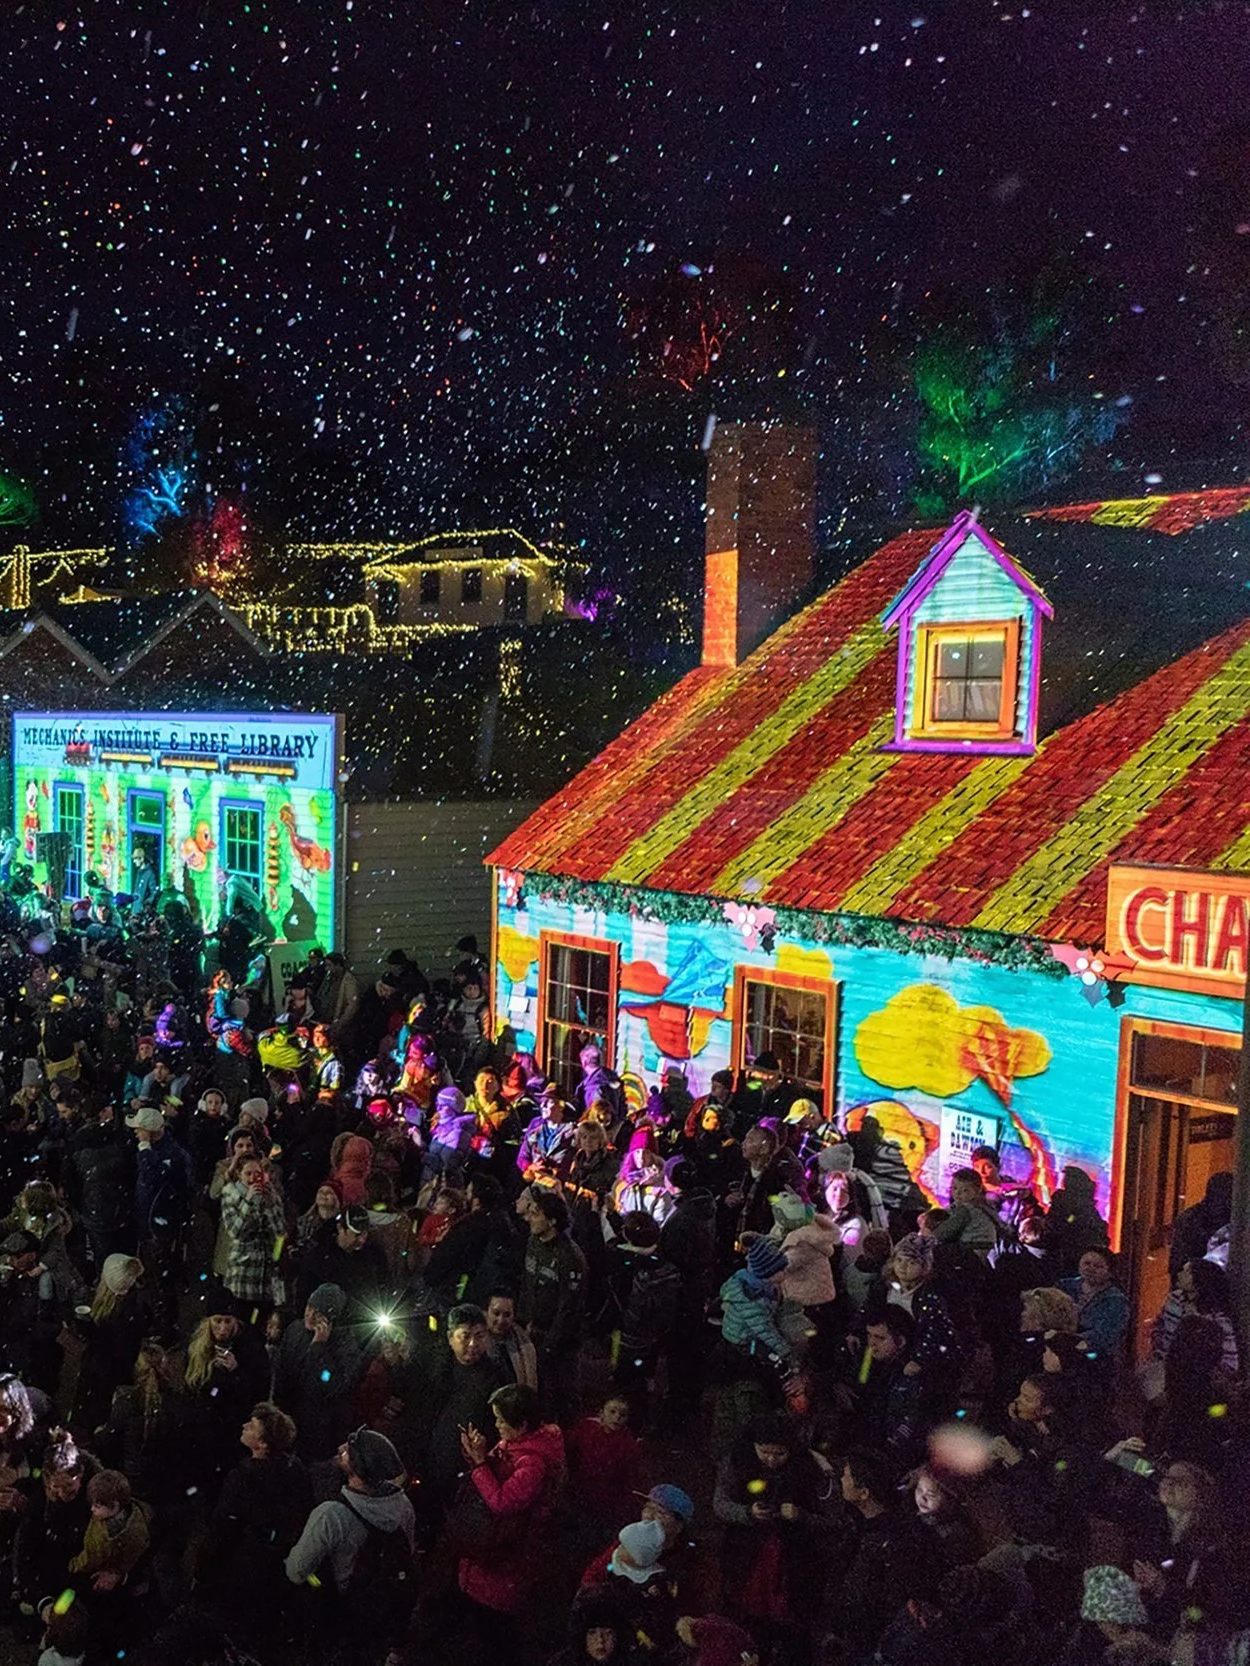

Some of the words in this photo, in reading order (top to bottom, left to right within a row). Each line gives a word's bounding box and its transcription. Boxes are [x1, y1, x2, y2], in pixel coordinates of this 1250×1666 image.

[93, 729, 161, 750] INSTITUTE
[169, 731, 180, 751] &
[189, 732, 230, 753] FREE
[239, 733, 319, 759] LIBRARY
[1122, 886, 1248, 976] CHA
[976, 1120, 984, 1136] &
